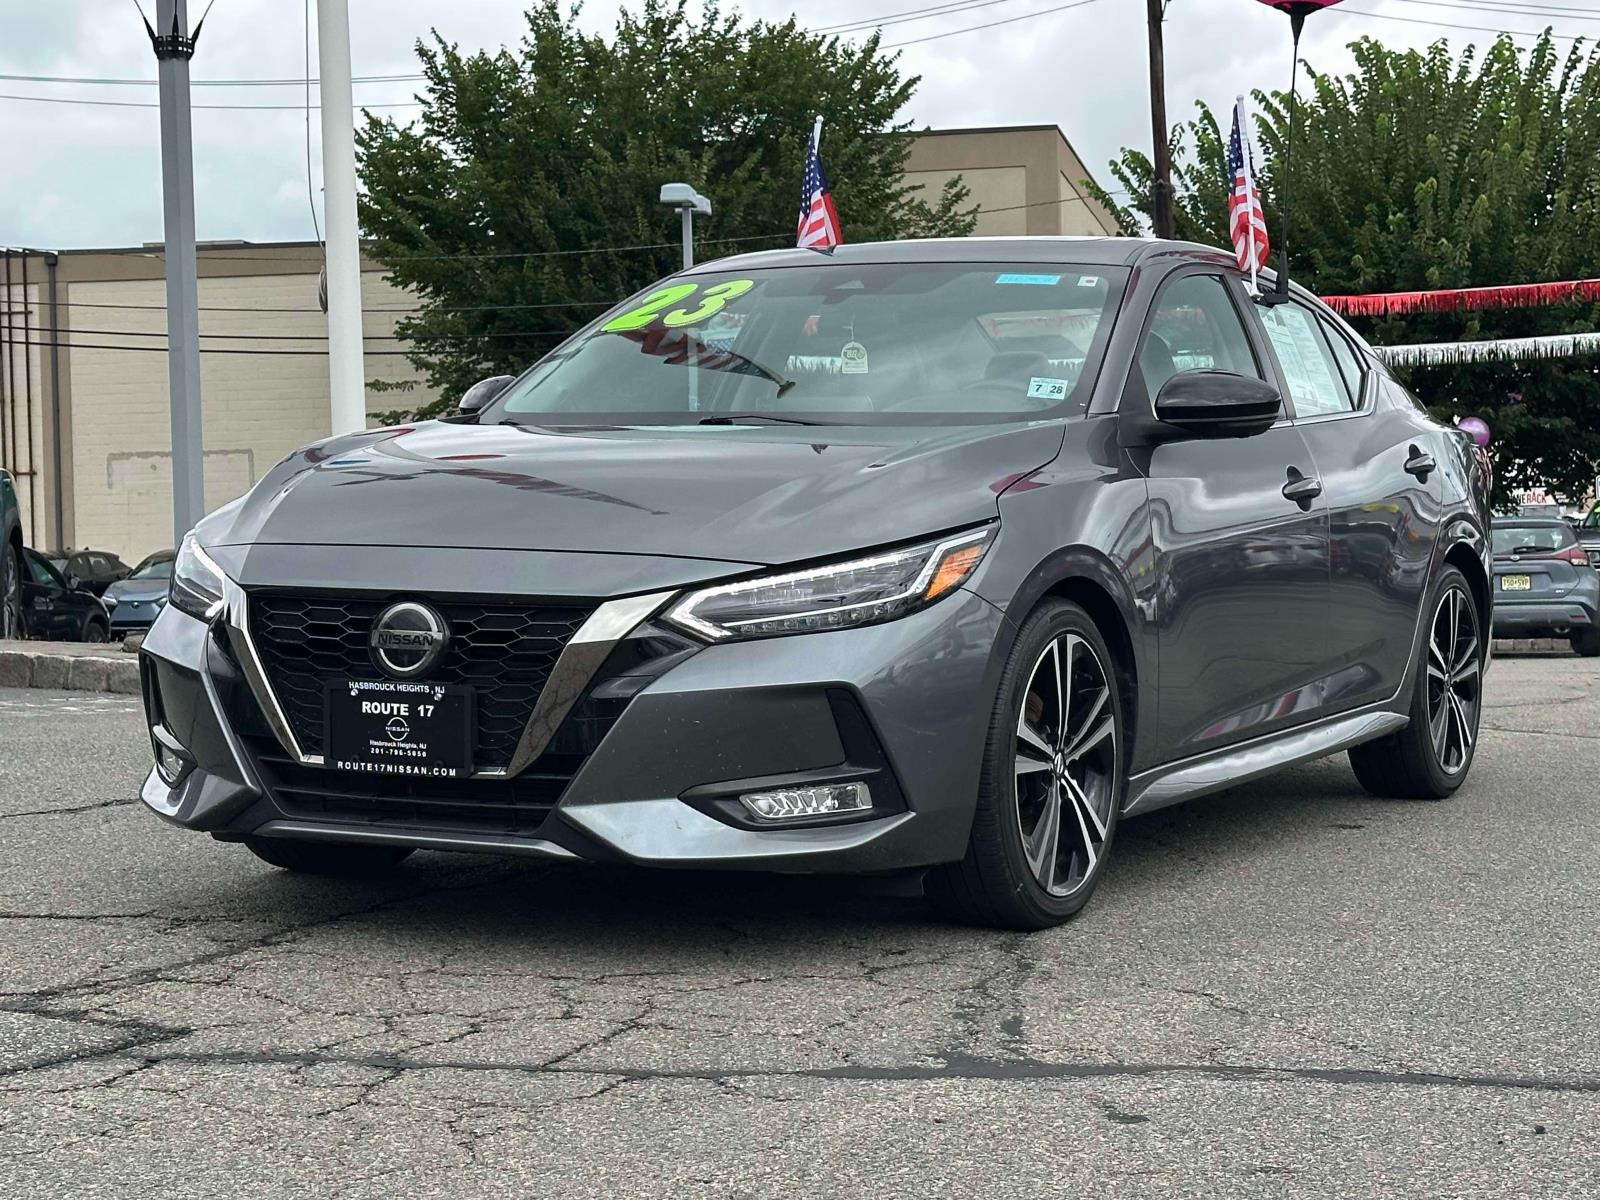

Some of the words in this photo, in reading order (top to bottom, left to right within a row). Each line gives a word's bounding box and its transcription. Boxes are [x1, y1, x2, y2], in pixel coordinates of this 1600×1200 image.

[601, 279, 754, 332] 23
[1035, 384, 1043, 393] 7
[1049, 385, 1064, 395] 28
[378, 632, 434, 646] NISSAN
[348, 681, 396, 692] HASBROUCK
[434, 685, 445, 694] NJ
[361, 701, 409, 716] ROUTE
[417, 704, 434, 717] 17
[337, 761, 456, 777] ROUTE17NISSAN.COM
